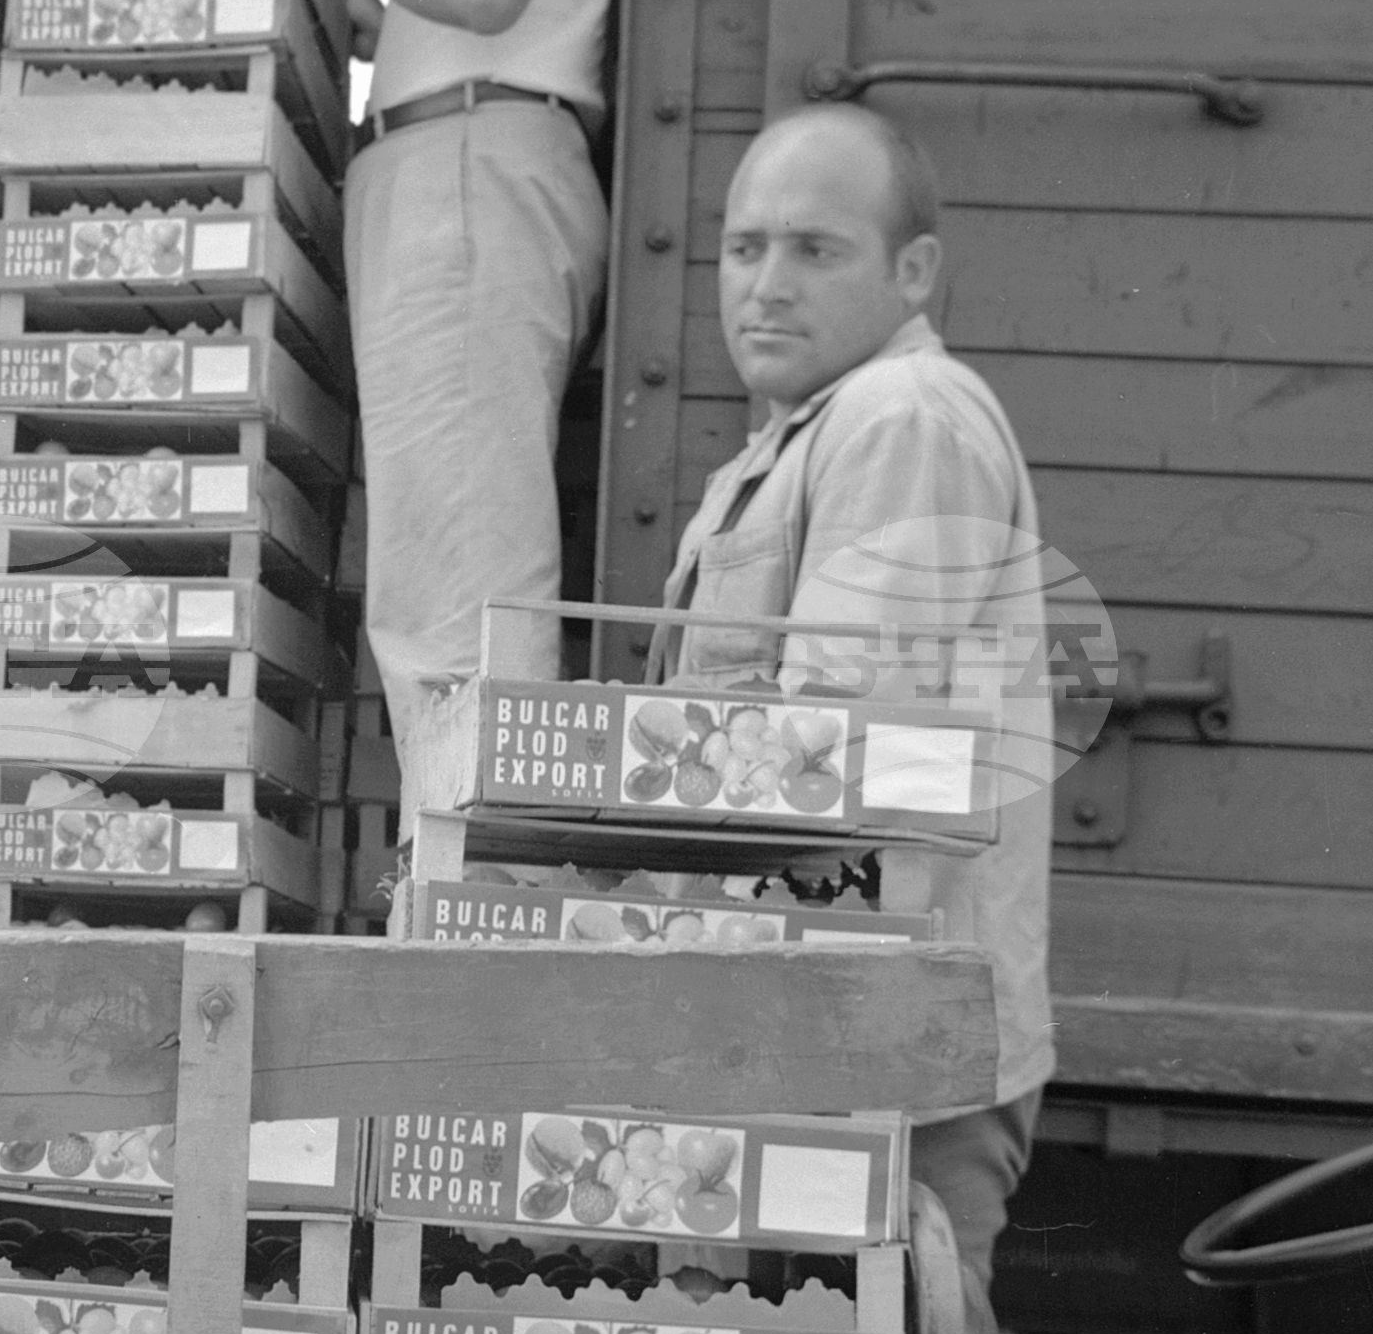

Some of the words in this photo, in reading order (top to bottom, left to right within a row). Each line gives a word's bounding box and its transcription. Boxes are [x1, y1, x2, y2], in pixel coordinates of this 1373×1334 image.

[497, 697, 610, 731] BULGAR
[496, 727, 568, 757] PLOD
[494, 756, 607, 790] EXPORT
[435, 898, 547, 933] BULGAR
[395, 1114, 507, 1147] BULGAR
[392, 1142, 465, 1173] PLOD
[390, 1171, 503, 1207] EXPORT
